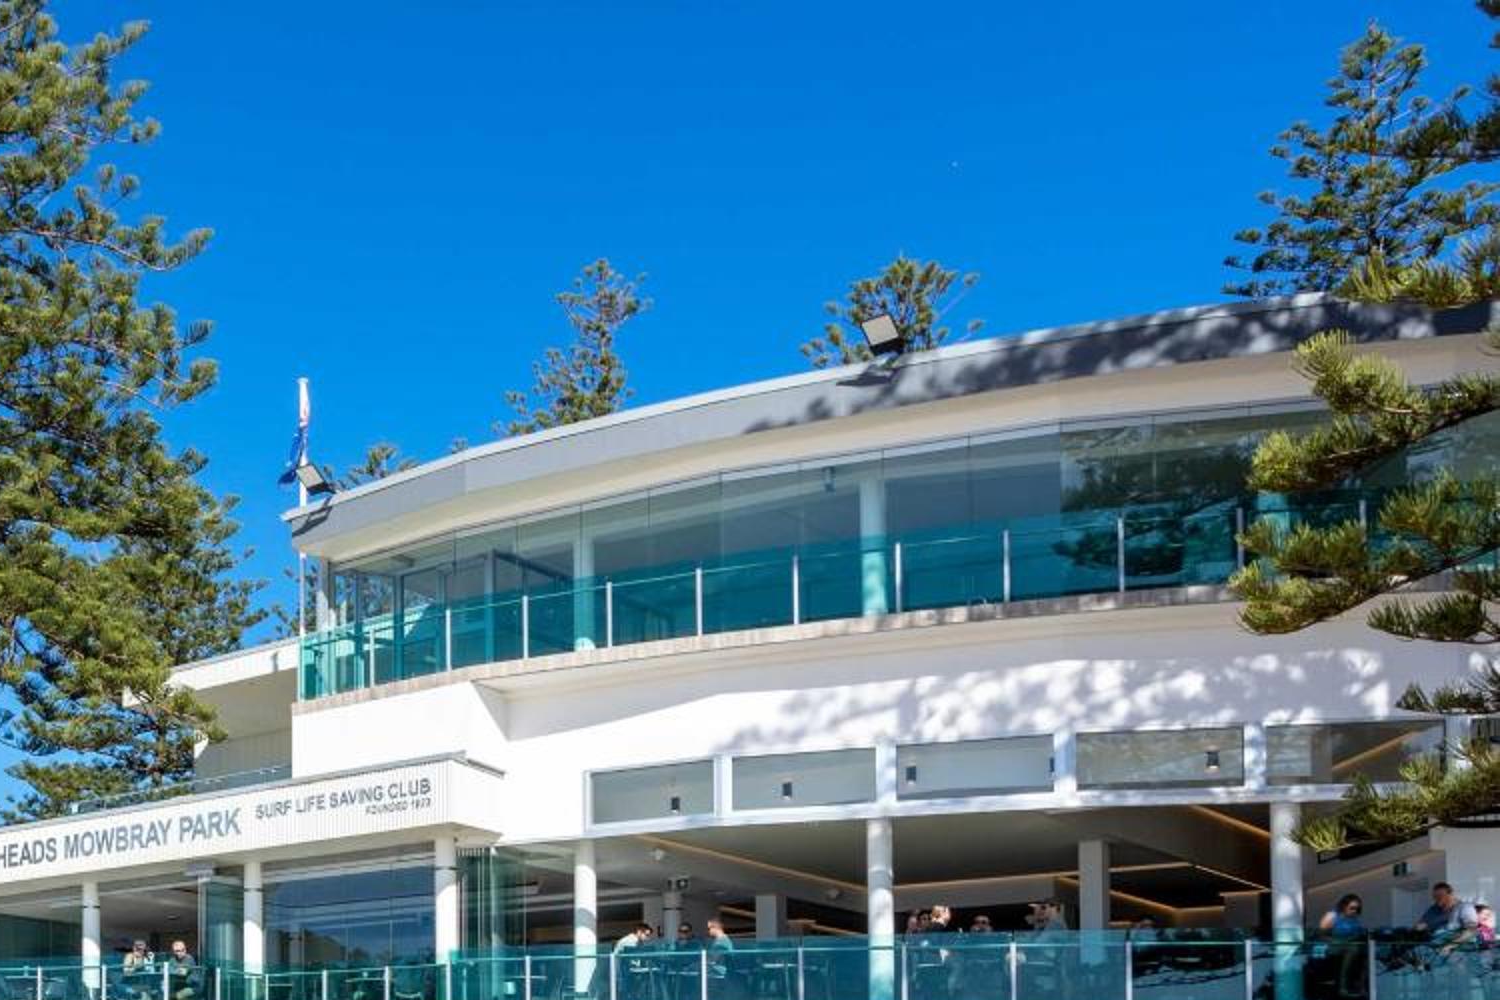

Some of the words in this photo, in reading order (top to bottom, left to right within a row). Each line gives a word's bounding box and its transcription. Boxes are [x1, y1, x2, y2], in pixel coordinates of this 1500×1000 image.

[255, 801, 292, 820] SURF
[296, 794, 325, 813] LIFE
[329, 785, 383, 808] SAVING
[387, 778, 431, 799] CLUB
[365, 800, 409, 815] FOUNDED
[63, 819, 172, 859] MOWBRAY
[179, 807, 242, 843] PARK
